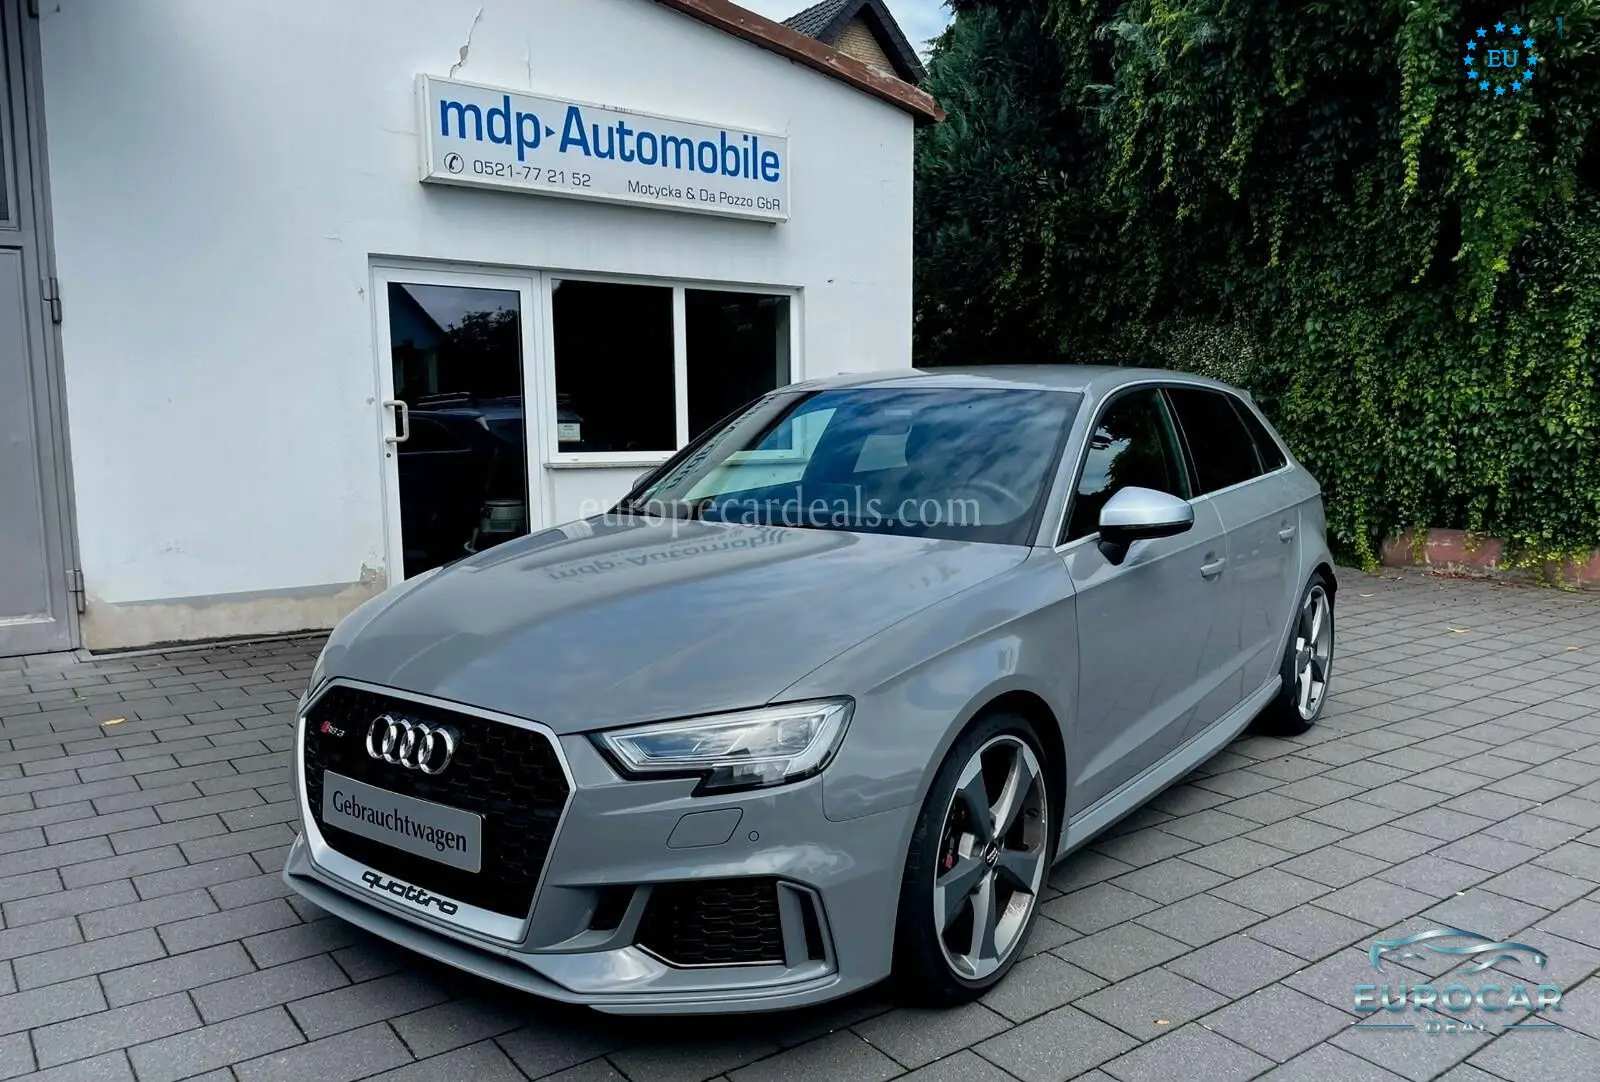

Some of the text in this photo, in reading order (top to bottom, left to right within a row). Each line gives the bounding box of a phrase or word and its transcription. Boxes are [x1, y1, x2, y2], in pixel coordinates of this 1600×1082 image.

[439, 94, 781, 184] mdp Automobile
[473, 159, 592, 188] 0521-77 21 52
[628, 179, 781, 211] Motycka & Da Pozzo GbR
[332, 790, 467, 853] Gebrauchtwagen
[361, 870, 459, 916] quattro
